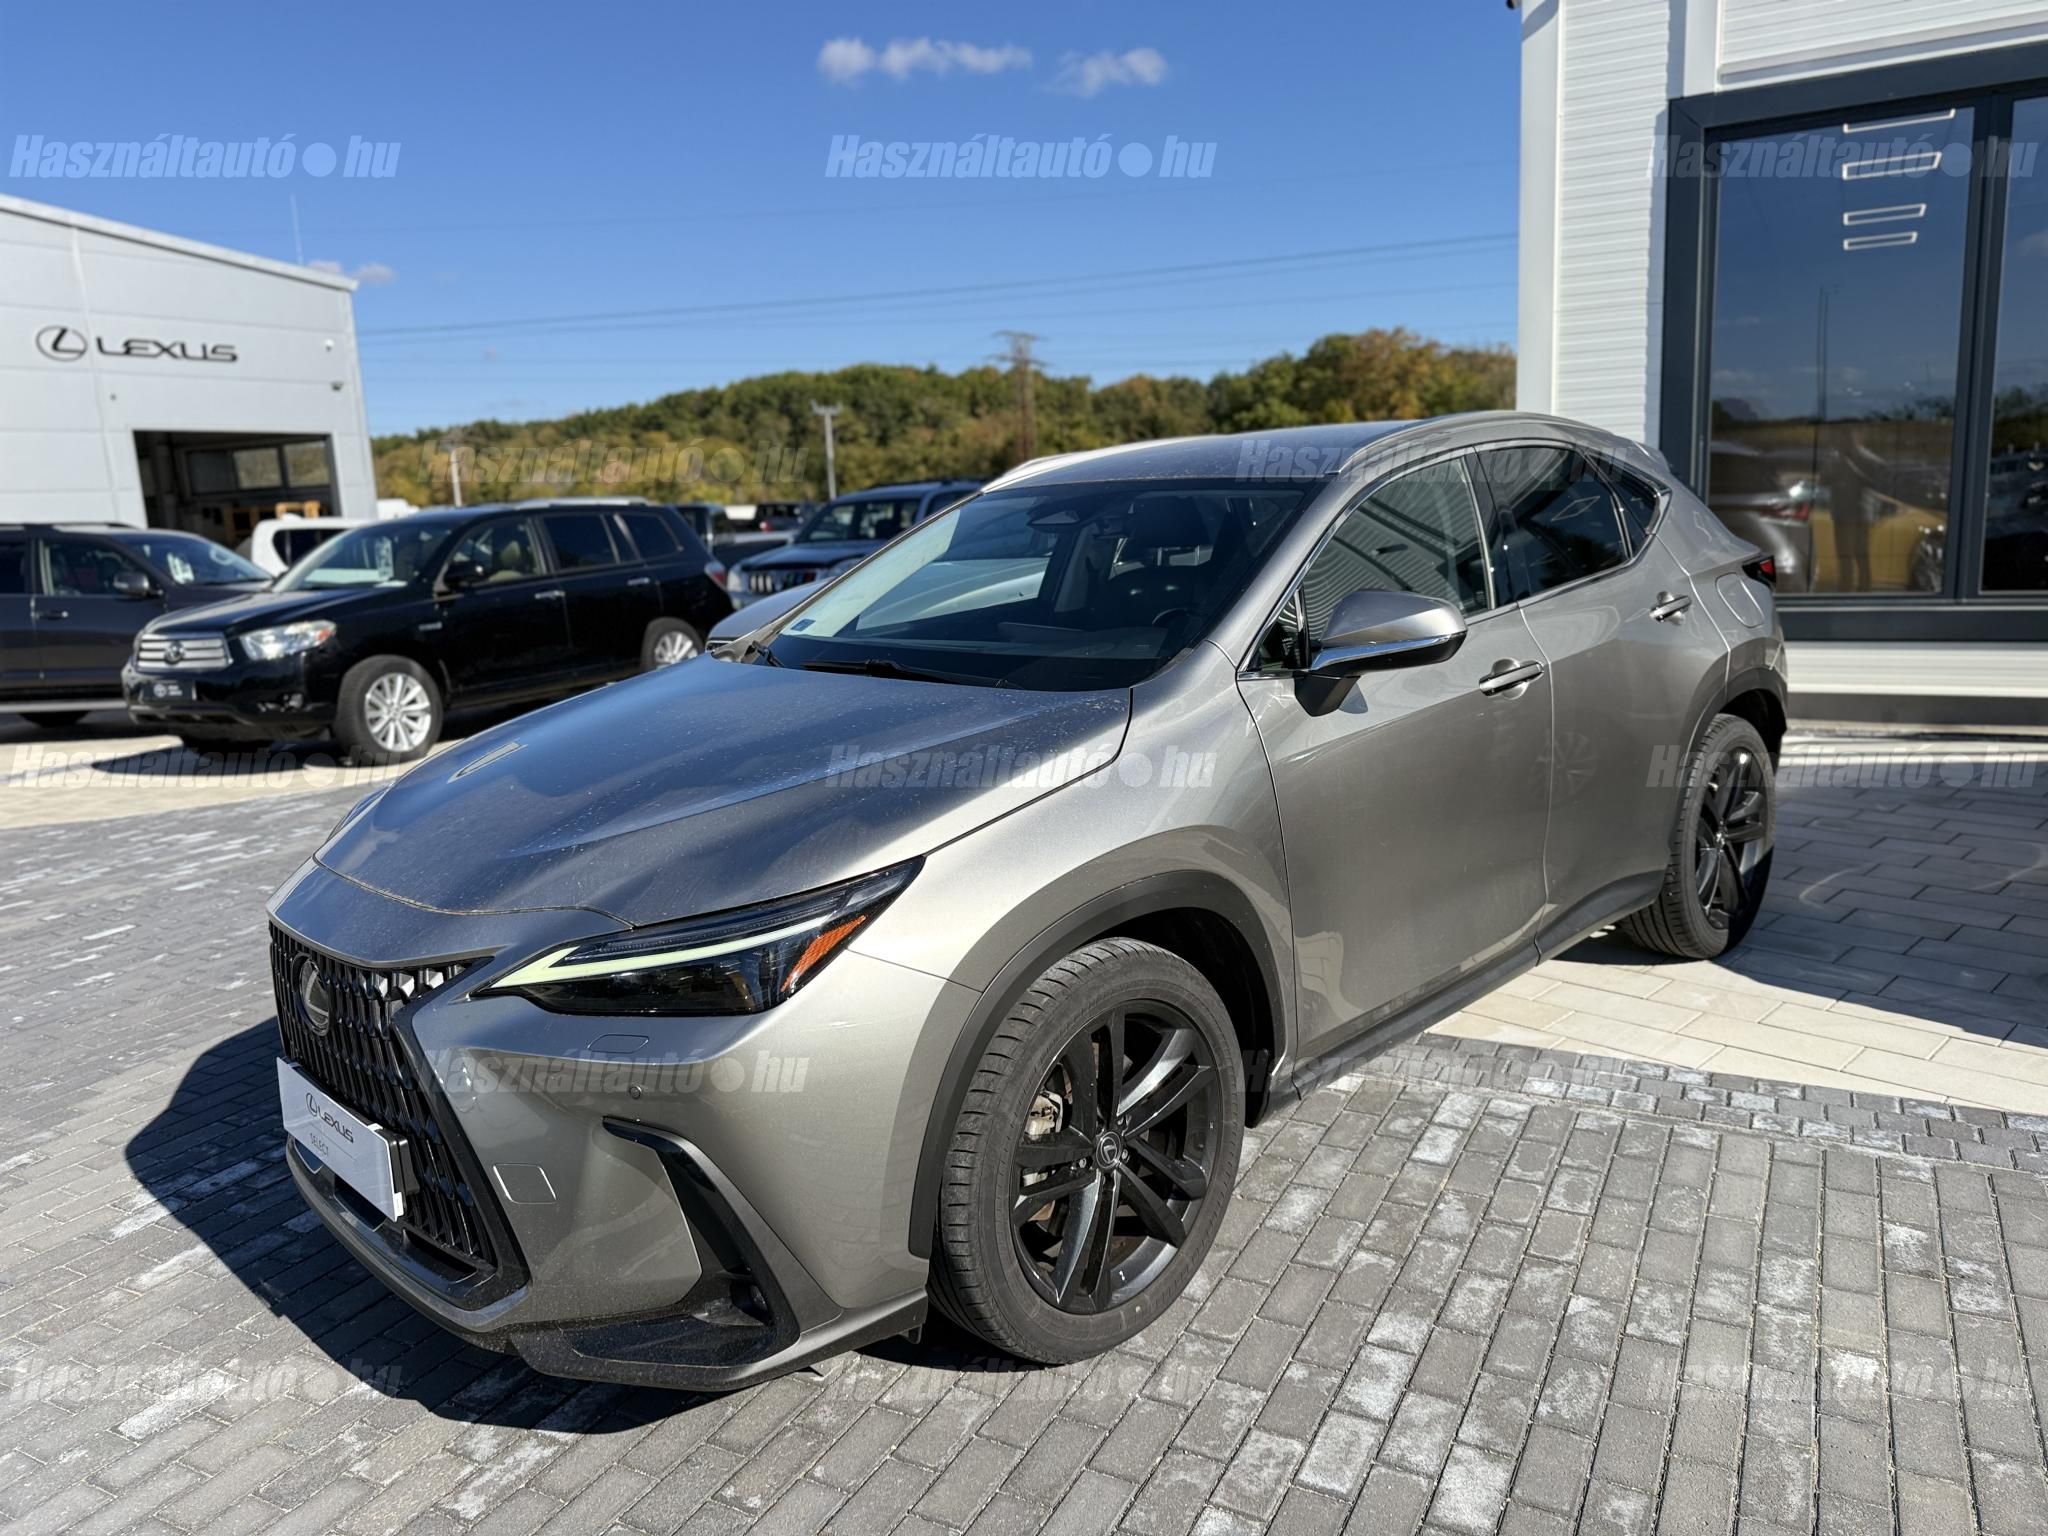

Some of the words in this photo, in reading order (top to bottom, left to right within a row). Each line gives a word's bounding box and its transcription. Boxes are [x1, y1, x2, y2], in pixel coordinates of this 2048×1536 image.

[96, 336, 238, 363] LEXUS
[317, 1105, 354, 1144] LEXUS
[310, 1132, 329, 1157] SELECT
